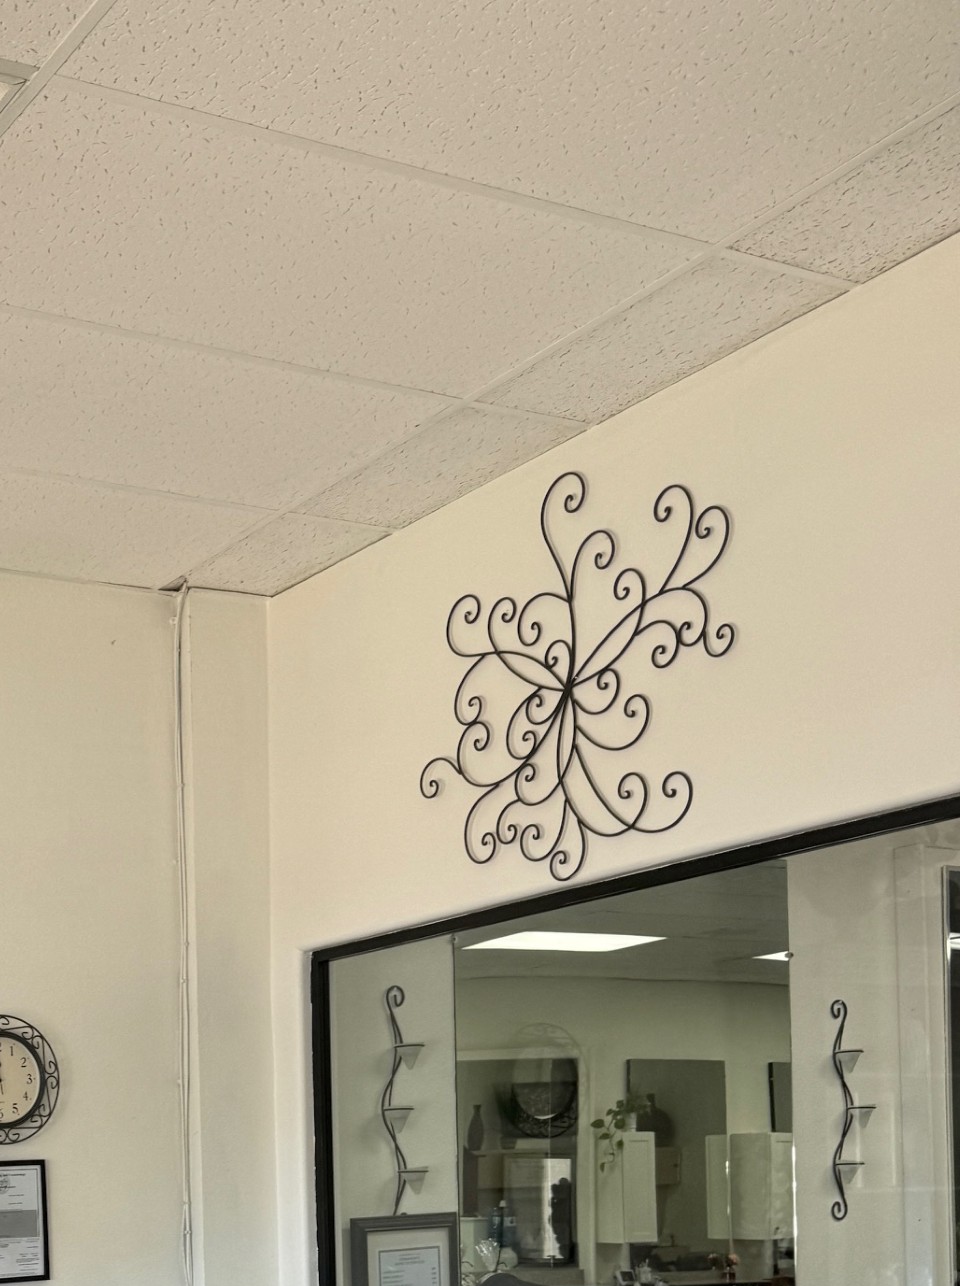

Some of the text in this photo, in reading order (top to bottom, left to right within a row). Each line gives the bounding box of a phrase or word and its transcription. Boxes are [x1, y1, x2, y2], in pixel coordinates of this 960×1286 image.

[10, 1046, 14, 1056] 1
[20, 1057, 27, 1067] 2
[26, 1074, 33, 1084] 3
[23, 1091, 28, 1101] 4
[12, 1103, 18, 1114] 5
